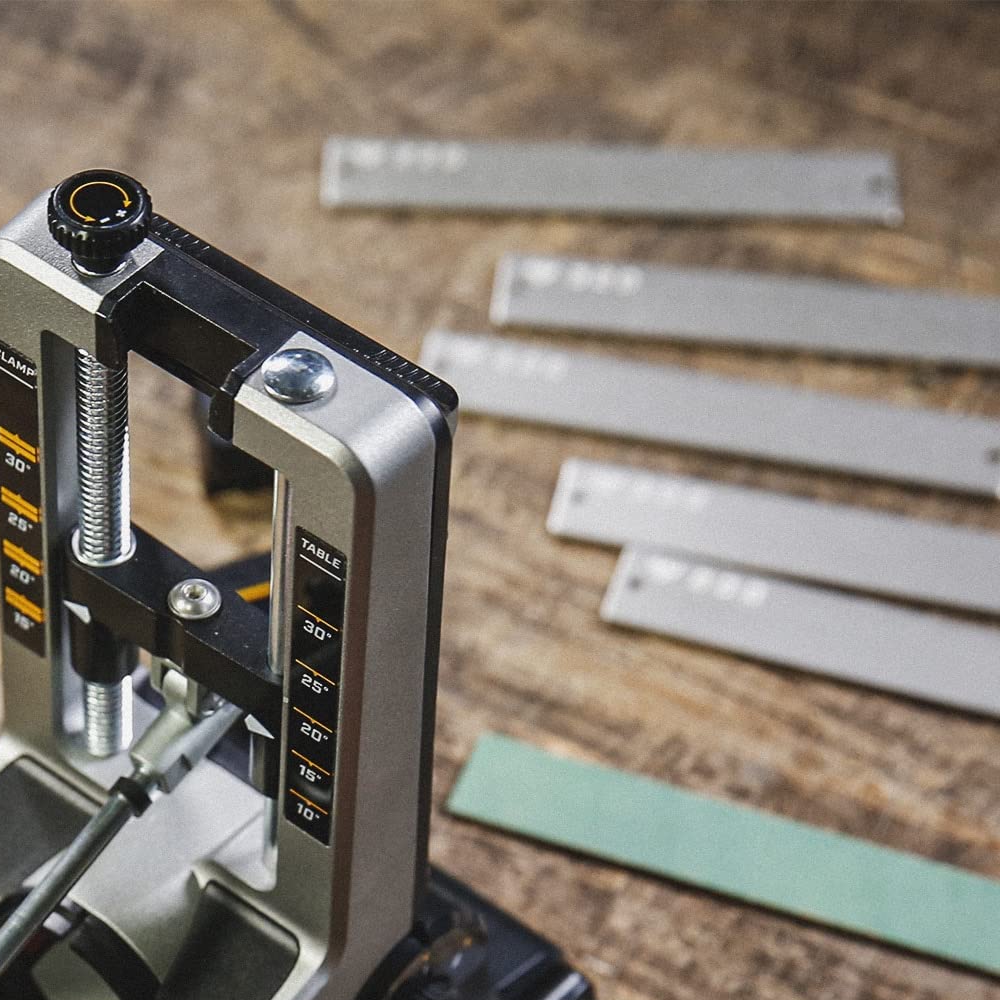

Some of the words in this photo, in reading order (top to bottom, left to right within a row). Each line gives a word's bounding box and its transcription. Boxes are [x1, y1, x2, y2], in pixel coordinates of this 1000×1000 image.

[5, 452, 31, 473] 30°
[7, 511, 33, 532] 25°
[301, 537, 341, 569] TABLE
[9, 563, 35, 584] 20°
[303, 619, 332, 641] 30°
[301, 673, 329, 694] 25°
[300, 722, 328, 742] 20°
[299, 764, 321, 783] 15°
[297, 802, 320, 821] 10°
